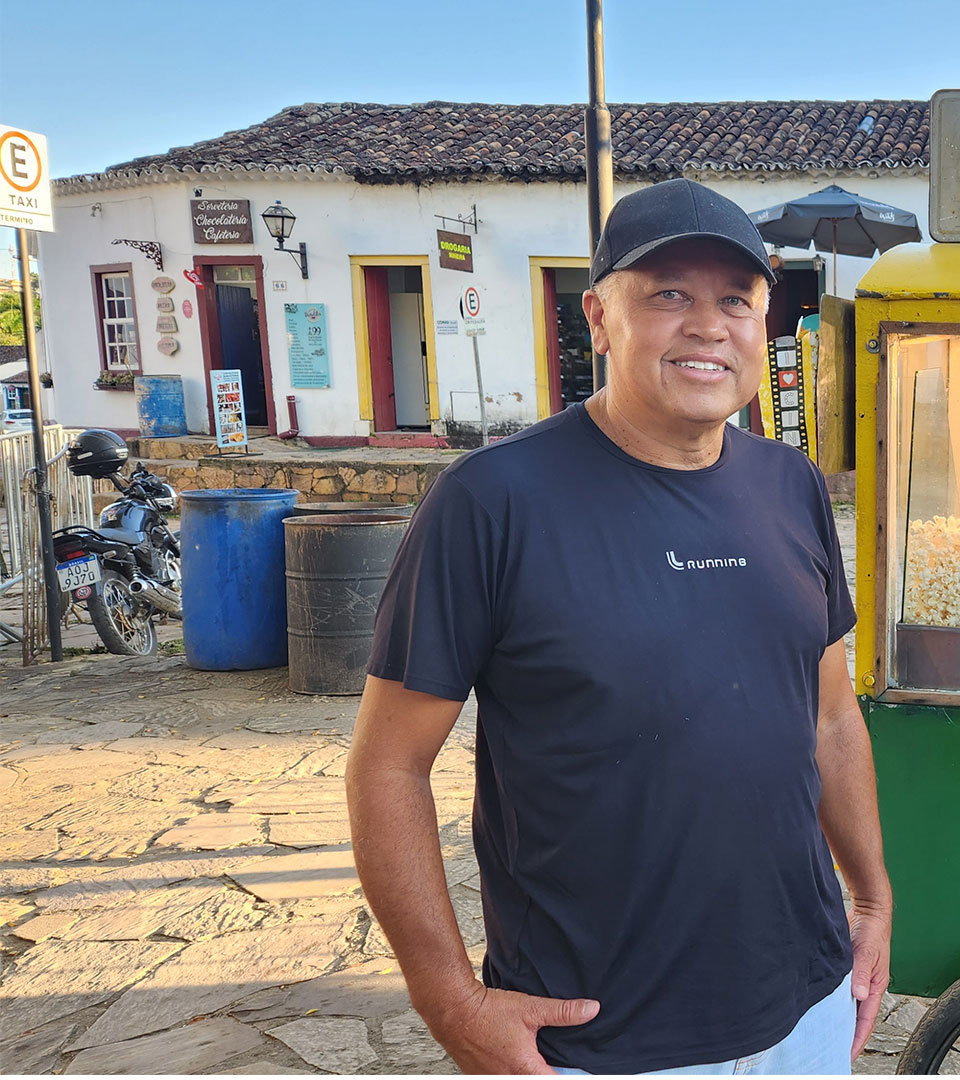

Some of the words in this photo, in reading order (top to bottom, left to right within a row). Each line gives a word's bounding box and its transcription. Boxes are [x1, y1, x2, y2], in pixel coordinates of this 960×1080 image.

[10, 142, 28, 179] E
[9, 194, 38, 208] TAXI
[203, 226, 241, 243] Cafeteria
[440, 240, 471, 255] DROGARIA
[469, 293, 476, 310] E
[67, 562, 89, 577] AOJ
[65, 570, 95, 589] 9J70
